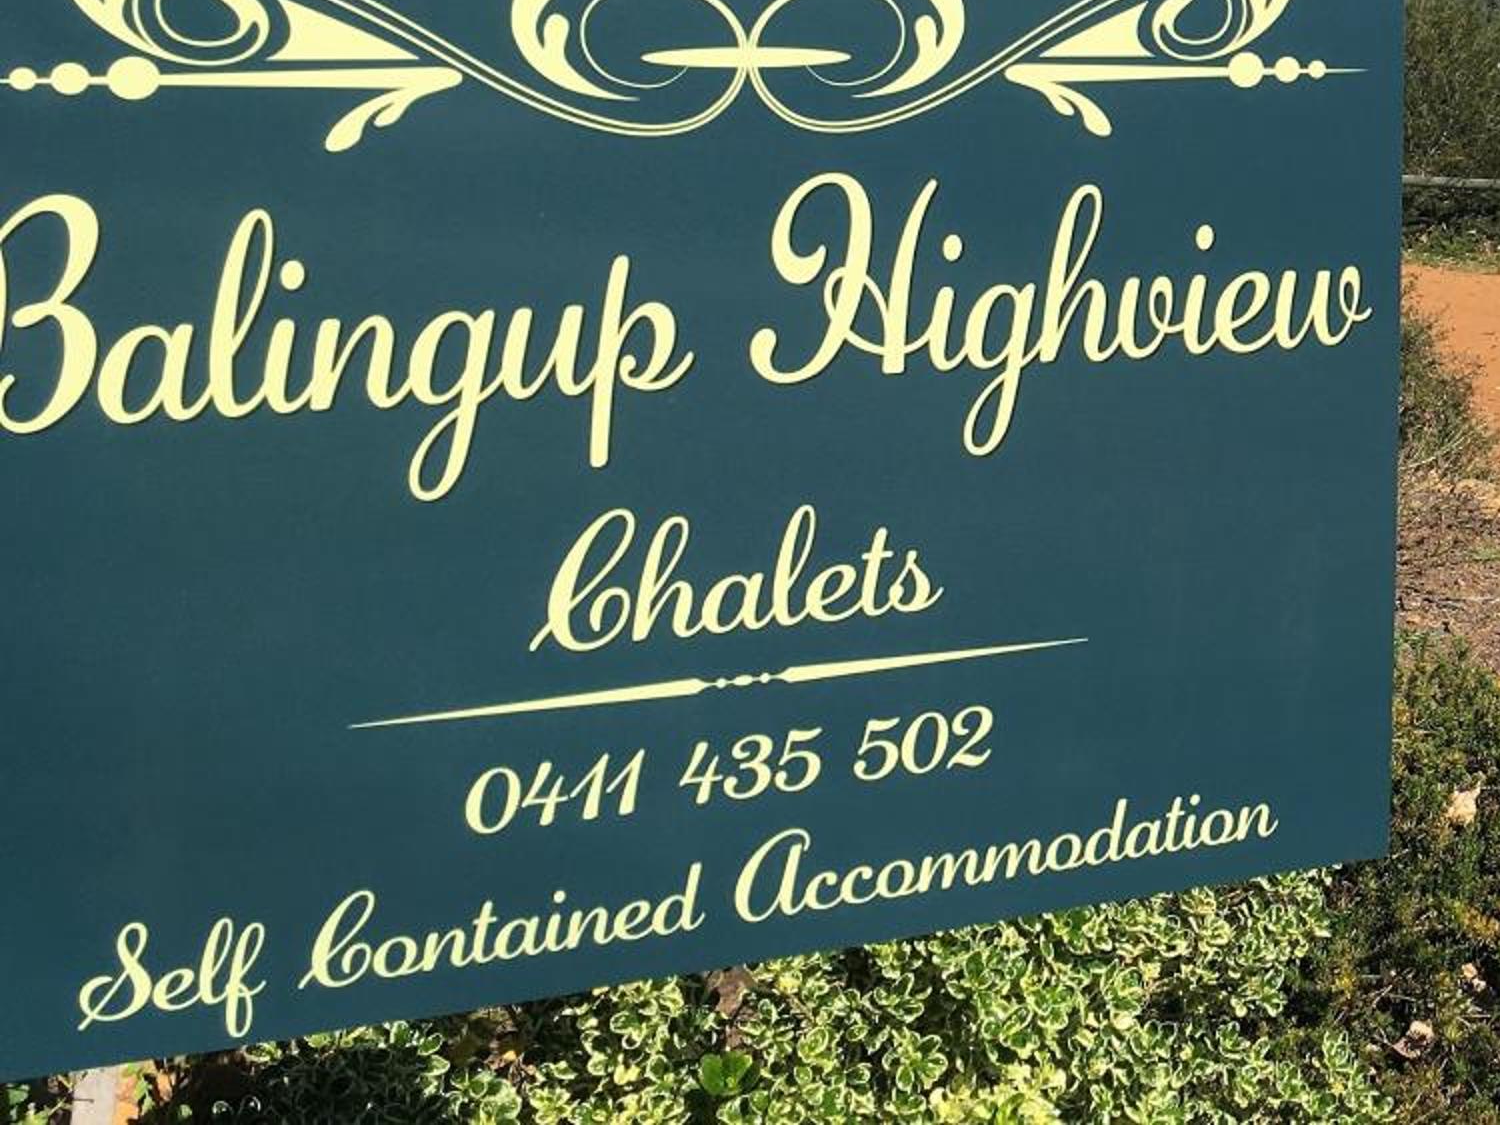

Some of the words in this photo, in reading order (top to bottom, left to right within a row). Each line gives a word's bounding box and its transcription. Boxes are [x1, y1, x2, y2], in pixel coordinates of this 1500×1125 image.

[0, 193, 694, 502] Balingup
[749, 172, 1373, 456] Highview
[529, 504, 944, 652] Chalets
[465, 748, 645, 834] 0411
[679, 727, 822, 805] 435
[853, 705, 993, 781] 502
[77, 917, 266, 1038] Self
[298, 862, 705, 990] Contained
[734, 794, 1279, 923] Accommodation
